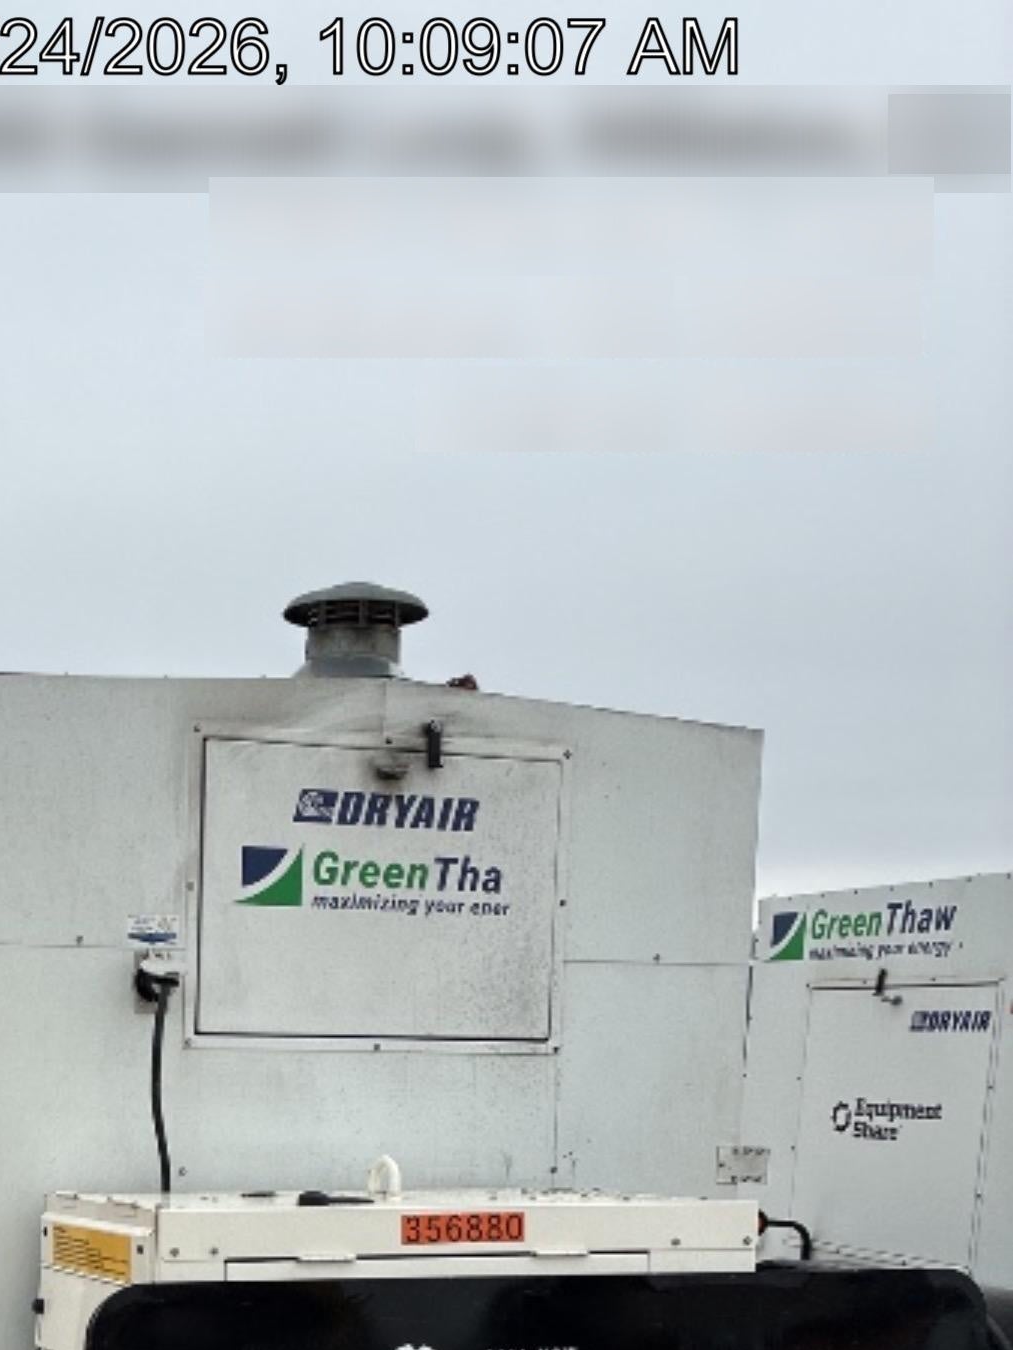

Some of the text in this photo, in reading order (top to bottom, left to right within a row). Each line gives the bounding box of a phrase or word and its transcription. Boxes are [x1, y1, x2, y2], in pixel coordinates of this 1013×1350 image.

[336, 790, 480, 832] DRYAIR
[311, 892, 421, 916] maximizing
[425, 900, 466, 918] your
[854, 1097, 943, 1122] Equipment
[405, 1214, 523, 1243] 356880
